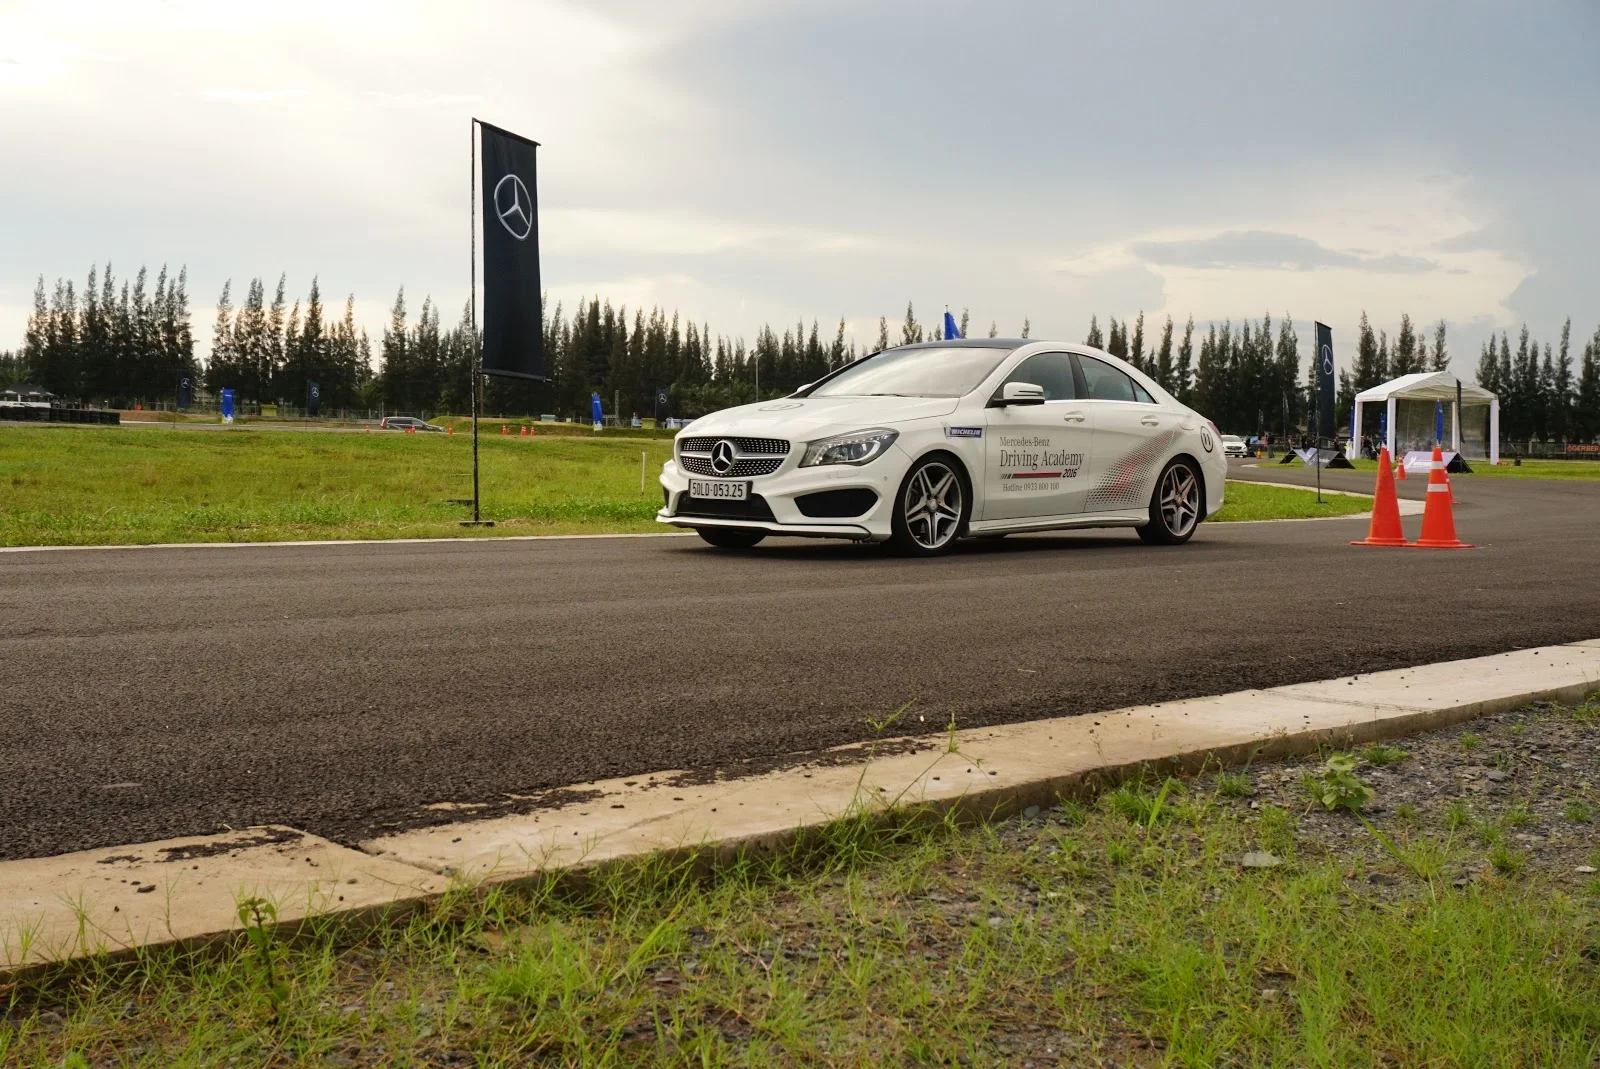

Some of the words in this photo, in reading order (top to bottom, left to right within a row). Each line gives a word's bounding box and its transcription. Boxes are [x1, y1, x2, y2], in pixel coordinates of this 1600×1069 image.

[1000, 436, 1050, 447] Mercedes-Benz
[1000, 449, 1038, 470] Driving
[1041, 449, 1085, 470] Academy
[1062, 468, 1077, 478] 2016
[1003, 483, 1022, 492] Hotline
[1023, 482, 1038, 491] 0933
[1050, 482, 1060, 491] 100
